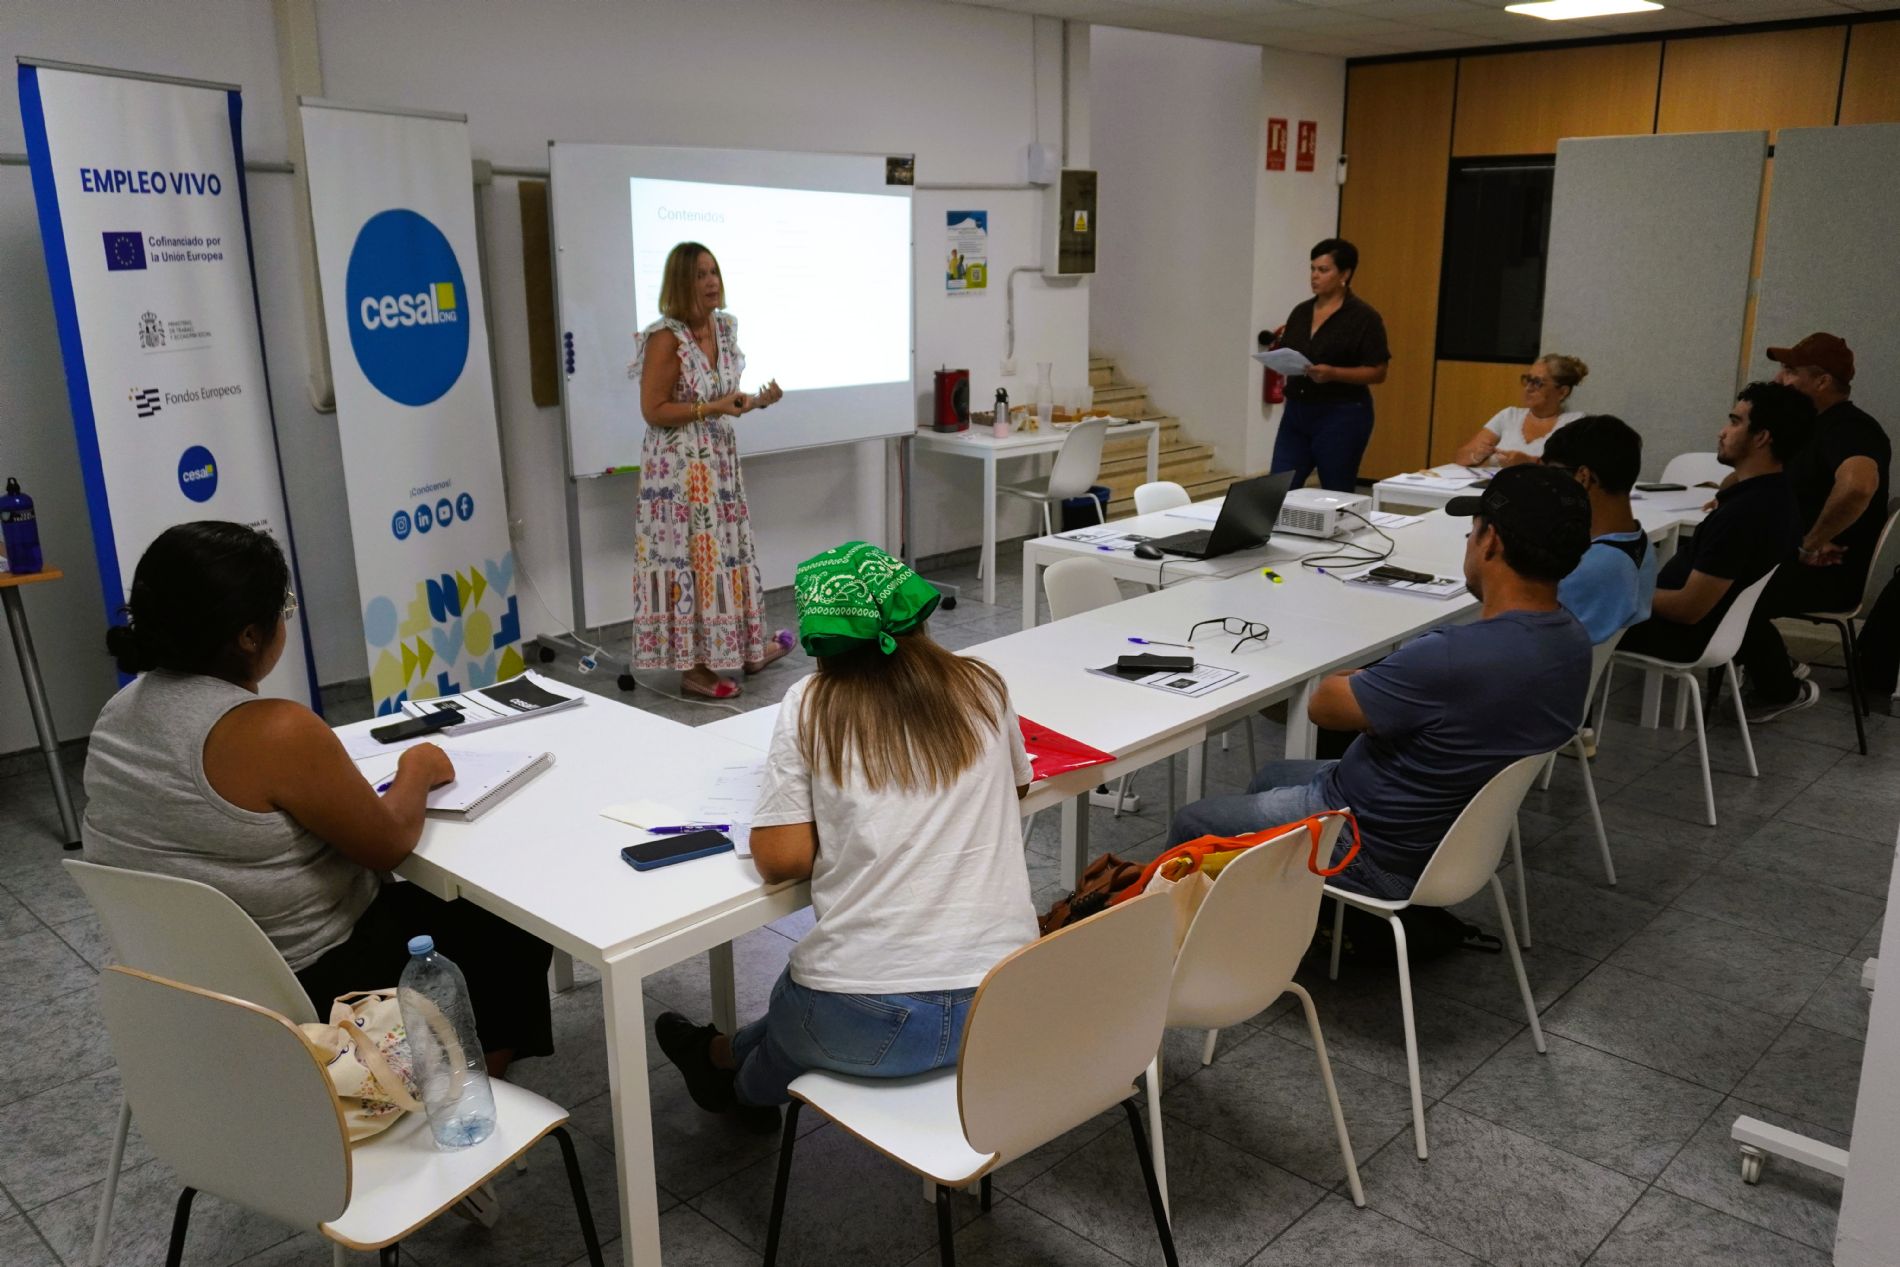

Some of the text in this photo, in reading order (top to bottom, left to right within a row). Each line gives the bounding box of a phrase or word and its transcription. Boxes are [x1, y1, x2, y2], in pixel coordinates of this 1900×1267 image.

[80, 168, 222, 196] EMPLEO VIVO
[657, 205, 726, 224] Contenidos
[148, 235, 221, 248] Cofinanciado por
[151, 252, 160, 262] la
[186, 250, 223, 263] Europea
[360, 282, 439, 330] cesal
[439, 311, 457, 323] ONG
[165, 384, 242, 405] Fondos Europeos
[182, 465, 208, 482] cesal
